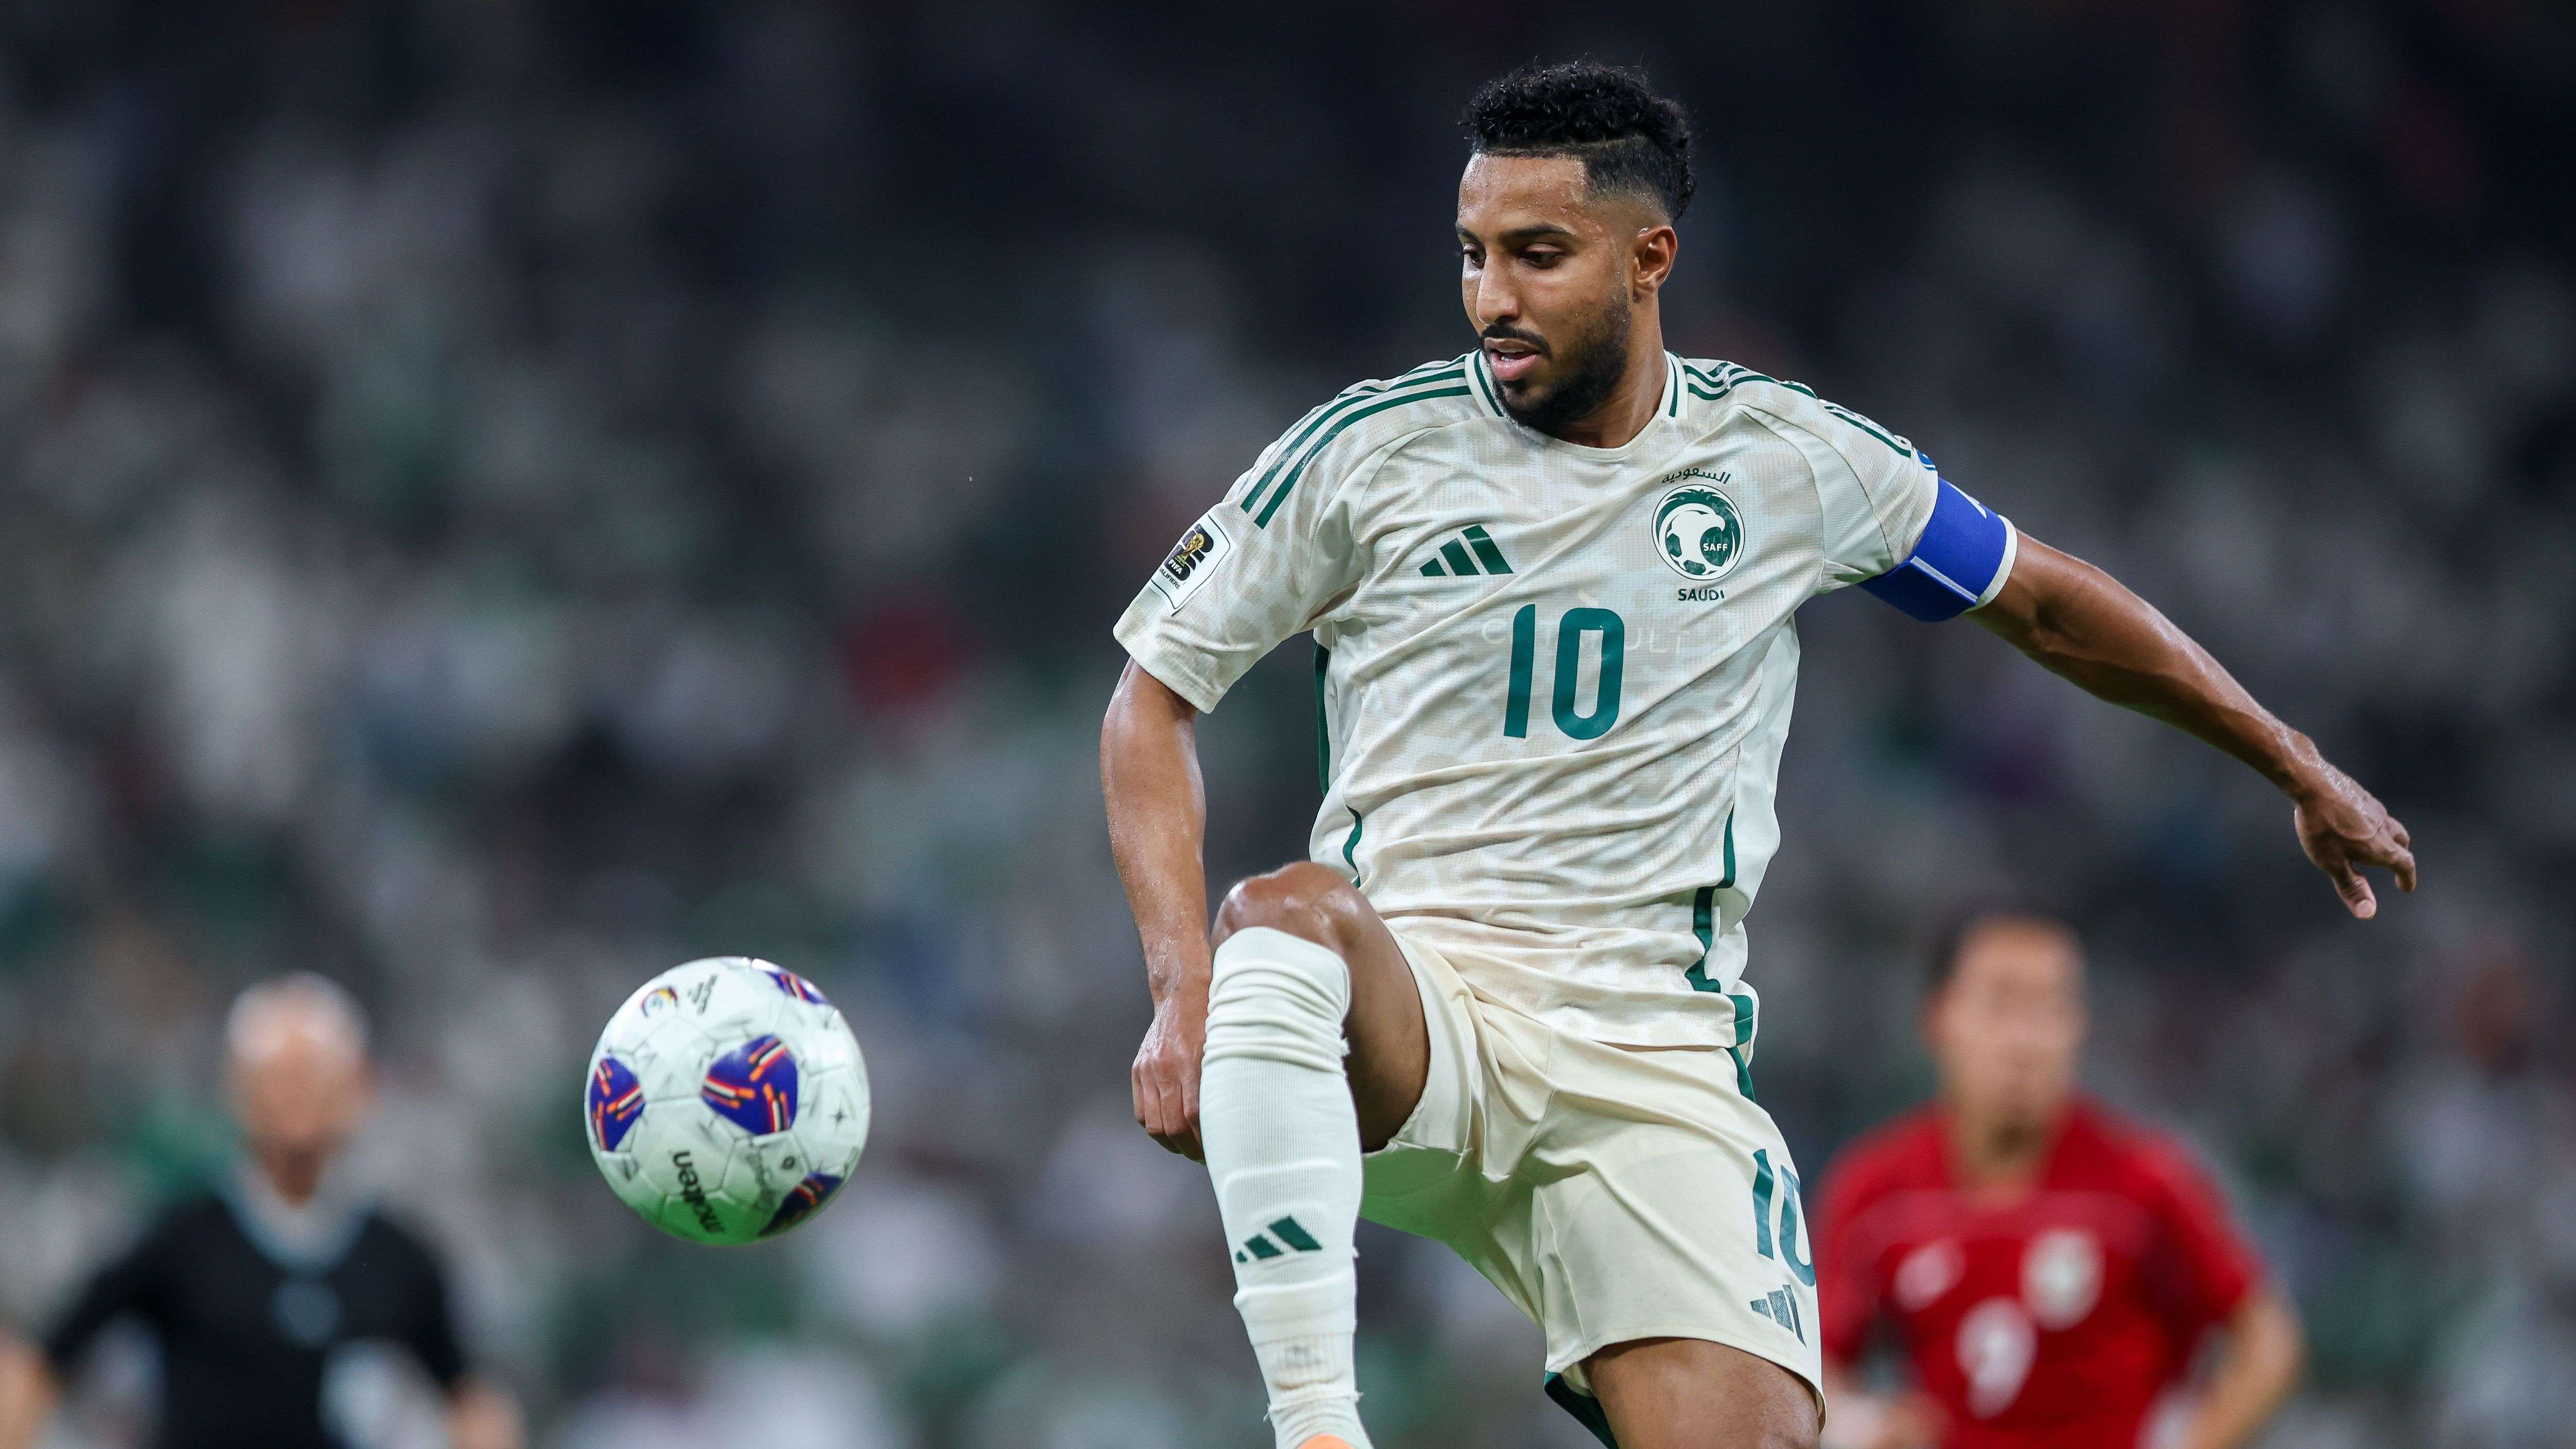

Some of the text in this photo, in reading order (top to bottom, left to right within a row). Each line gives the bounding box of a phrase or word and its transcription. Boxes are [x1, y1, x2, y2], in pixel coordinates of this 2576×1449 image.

[1661, 467, 1731, 484] السعودية
[1703, 543, 1728, 552] SAFF
[1168, 558, 1182, 574] FIFA
[1159, 567, 1180, 589] ALIFIERS
[1677, 588, 1725, 601] SAUDI
[1504, 604, 1625, 740] 10
[1752, 1148, 1816, 1287] 10
